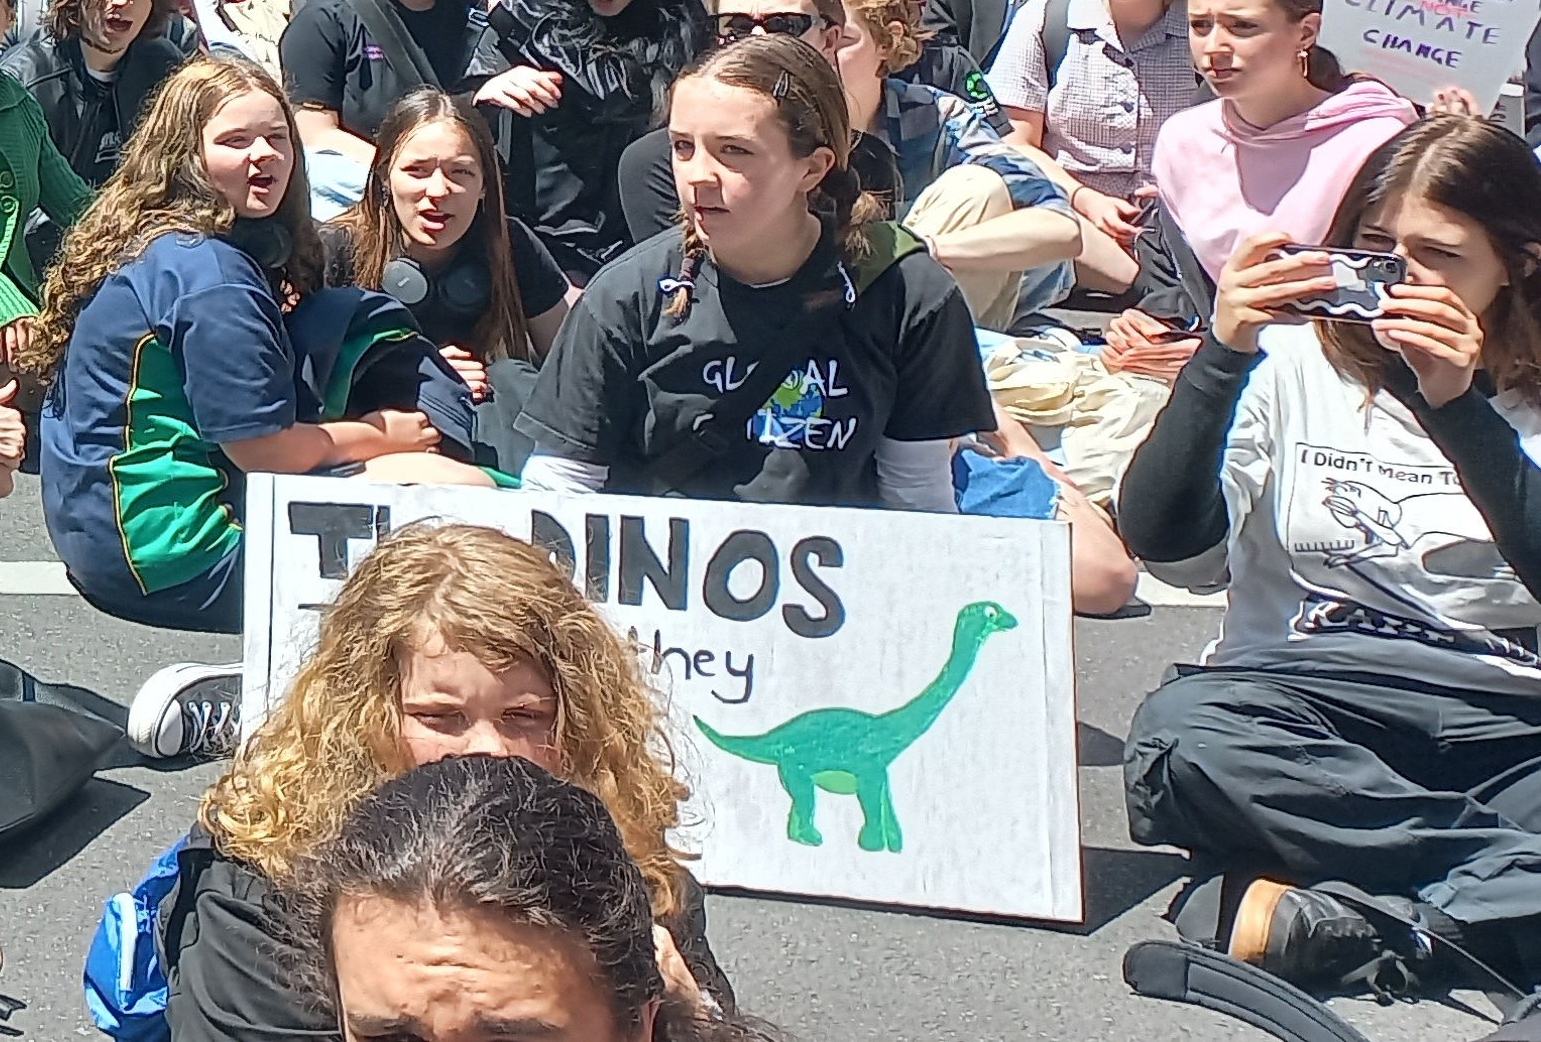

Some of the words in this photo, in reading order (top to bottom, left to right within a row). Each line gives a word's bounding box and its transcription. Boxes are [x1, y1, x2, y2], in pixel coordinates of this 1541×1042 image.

[1363, 28, 1464, 69] CHANGE
[1301, 449, 1308, 464] I
[1314, 452, 1374, 472] Didn't
[1378, 465, 1434, 486] Mean
[530, 508, 846, 639] DINOS
